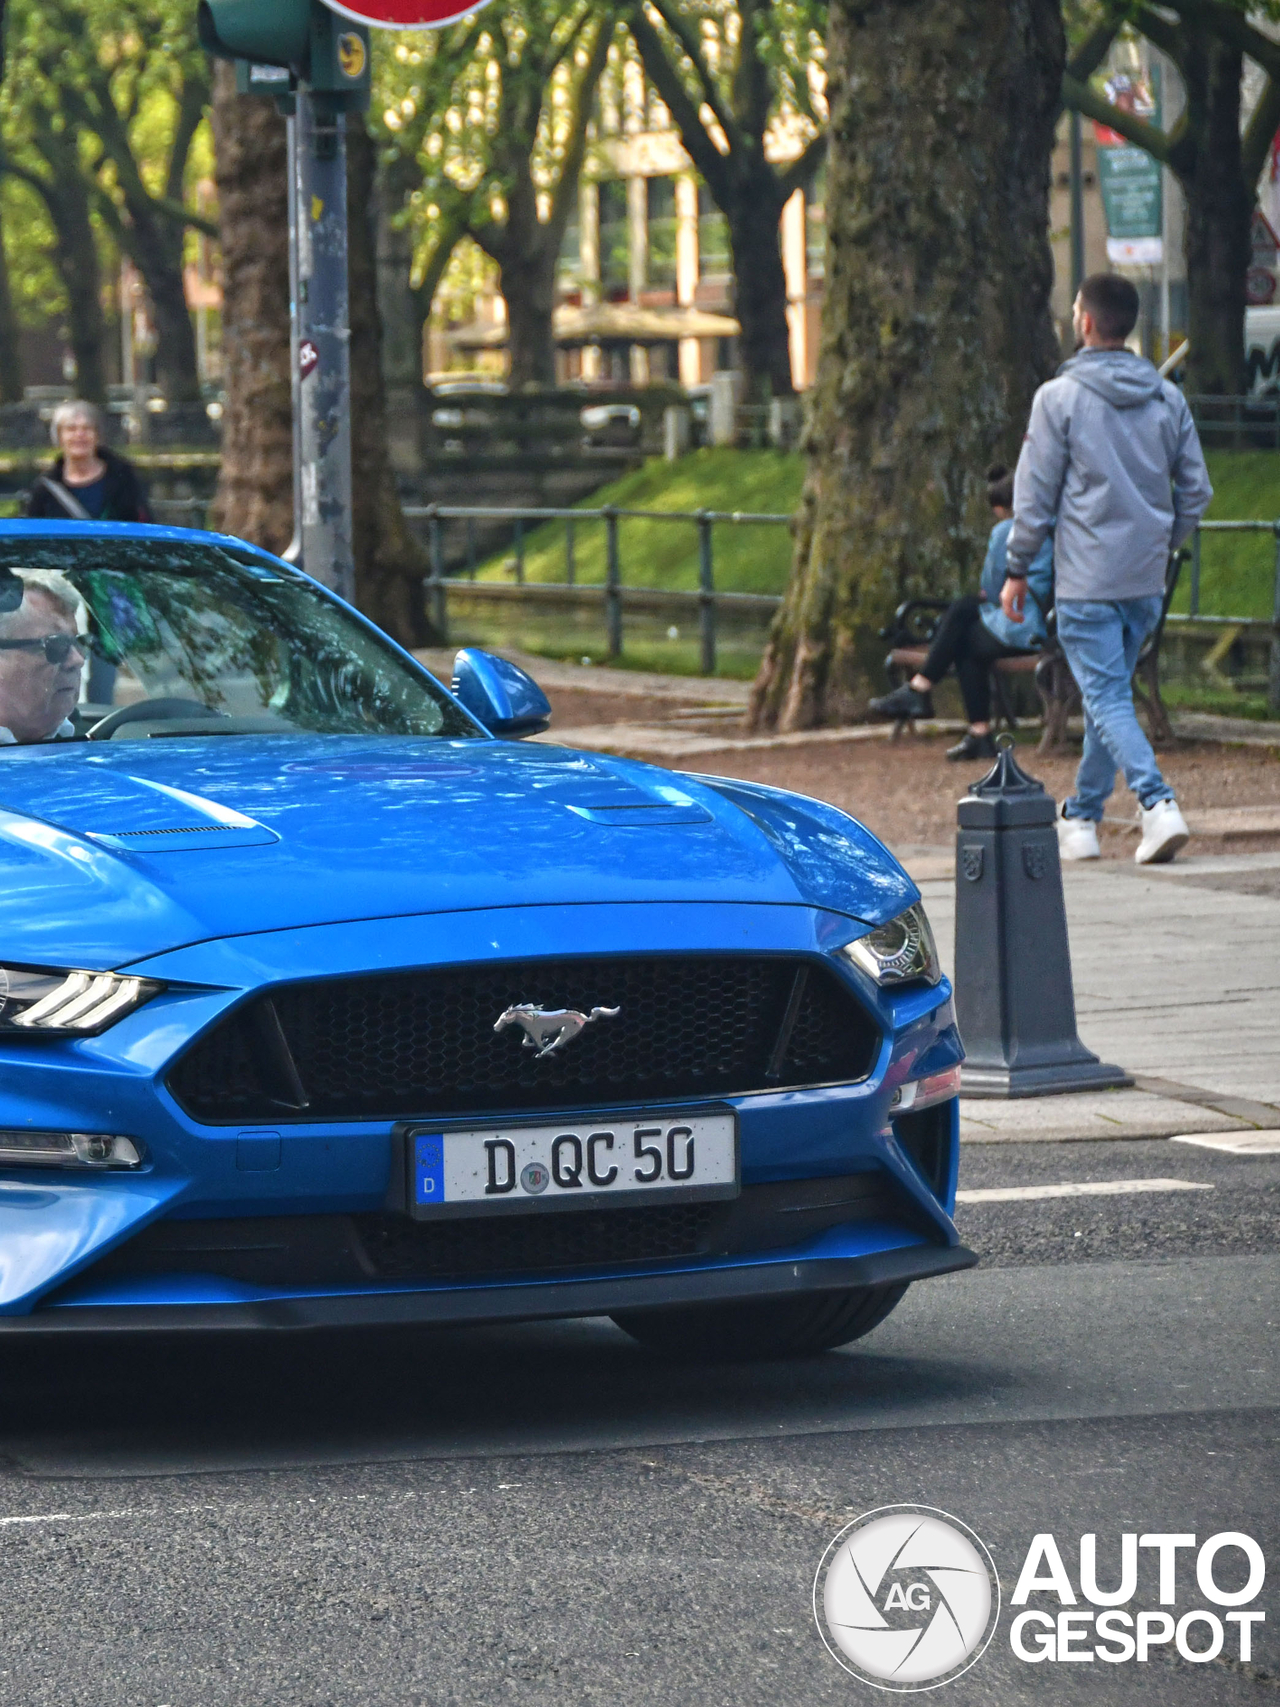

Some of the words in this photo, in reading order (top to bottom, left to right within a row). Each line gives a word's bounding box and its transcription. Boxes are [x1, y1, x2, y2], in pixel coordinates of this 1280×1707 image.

[484, 1138, 516, 1194] D
[551, 1131, 618, 1188] QC
[634, 1126, 695, 1183] 50
[423, 1177, 435, 1194] D
